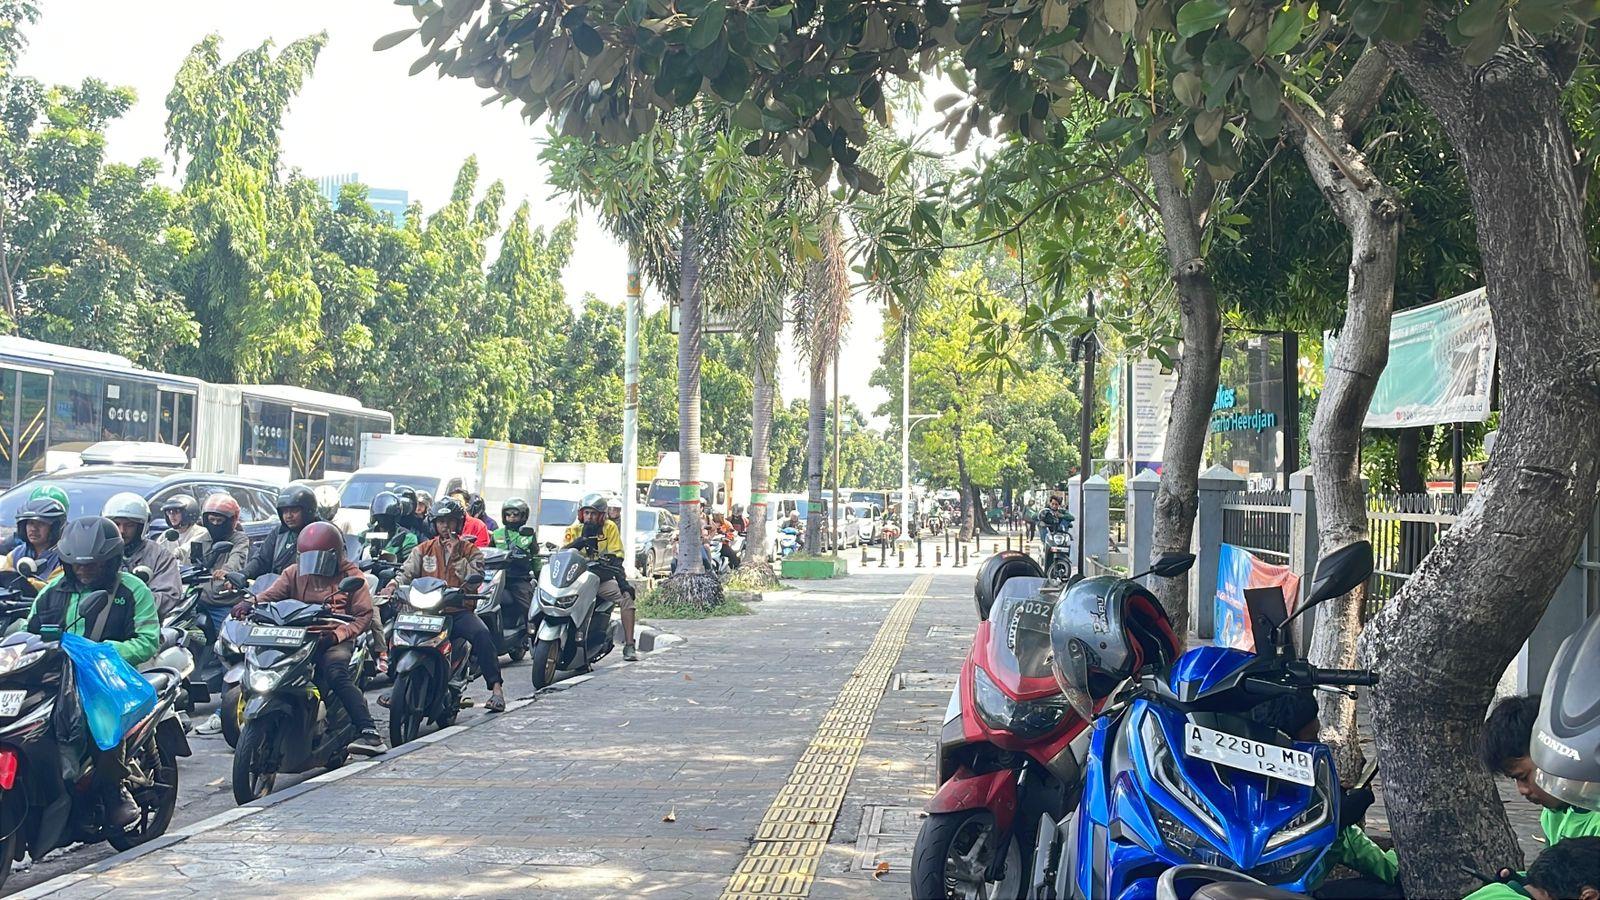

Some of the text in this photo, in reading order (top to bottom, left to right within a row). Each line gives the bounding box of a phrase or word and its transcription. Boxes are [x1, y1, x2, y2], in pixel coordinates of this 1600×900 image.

[1231, 408, 1275, 433] Heerdjan
[1191, 727, 1202, 741] A
[1214, 733, 1265, 758] 2290
[1537, 730, 1581, 761] HONDA
